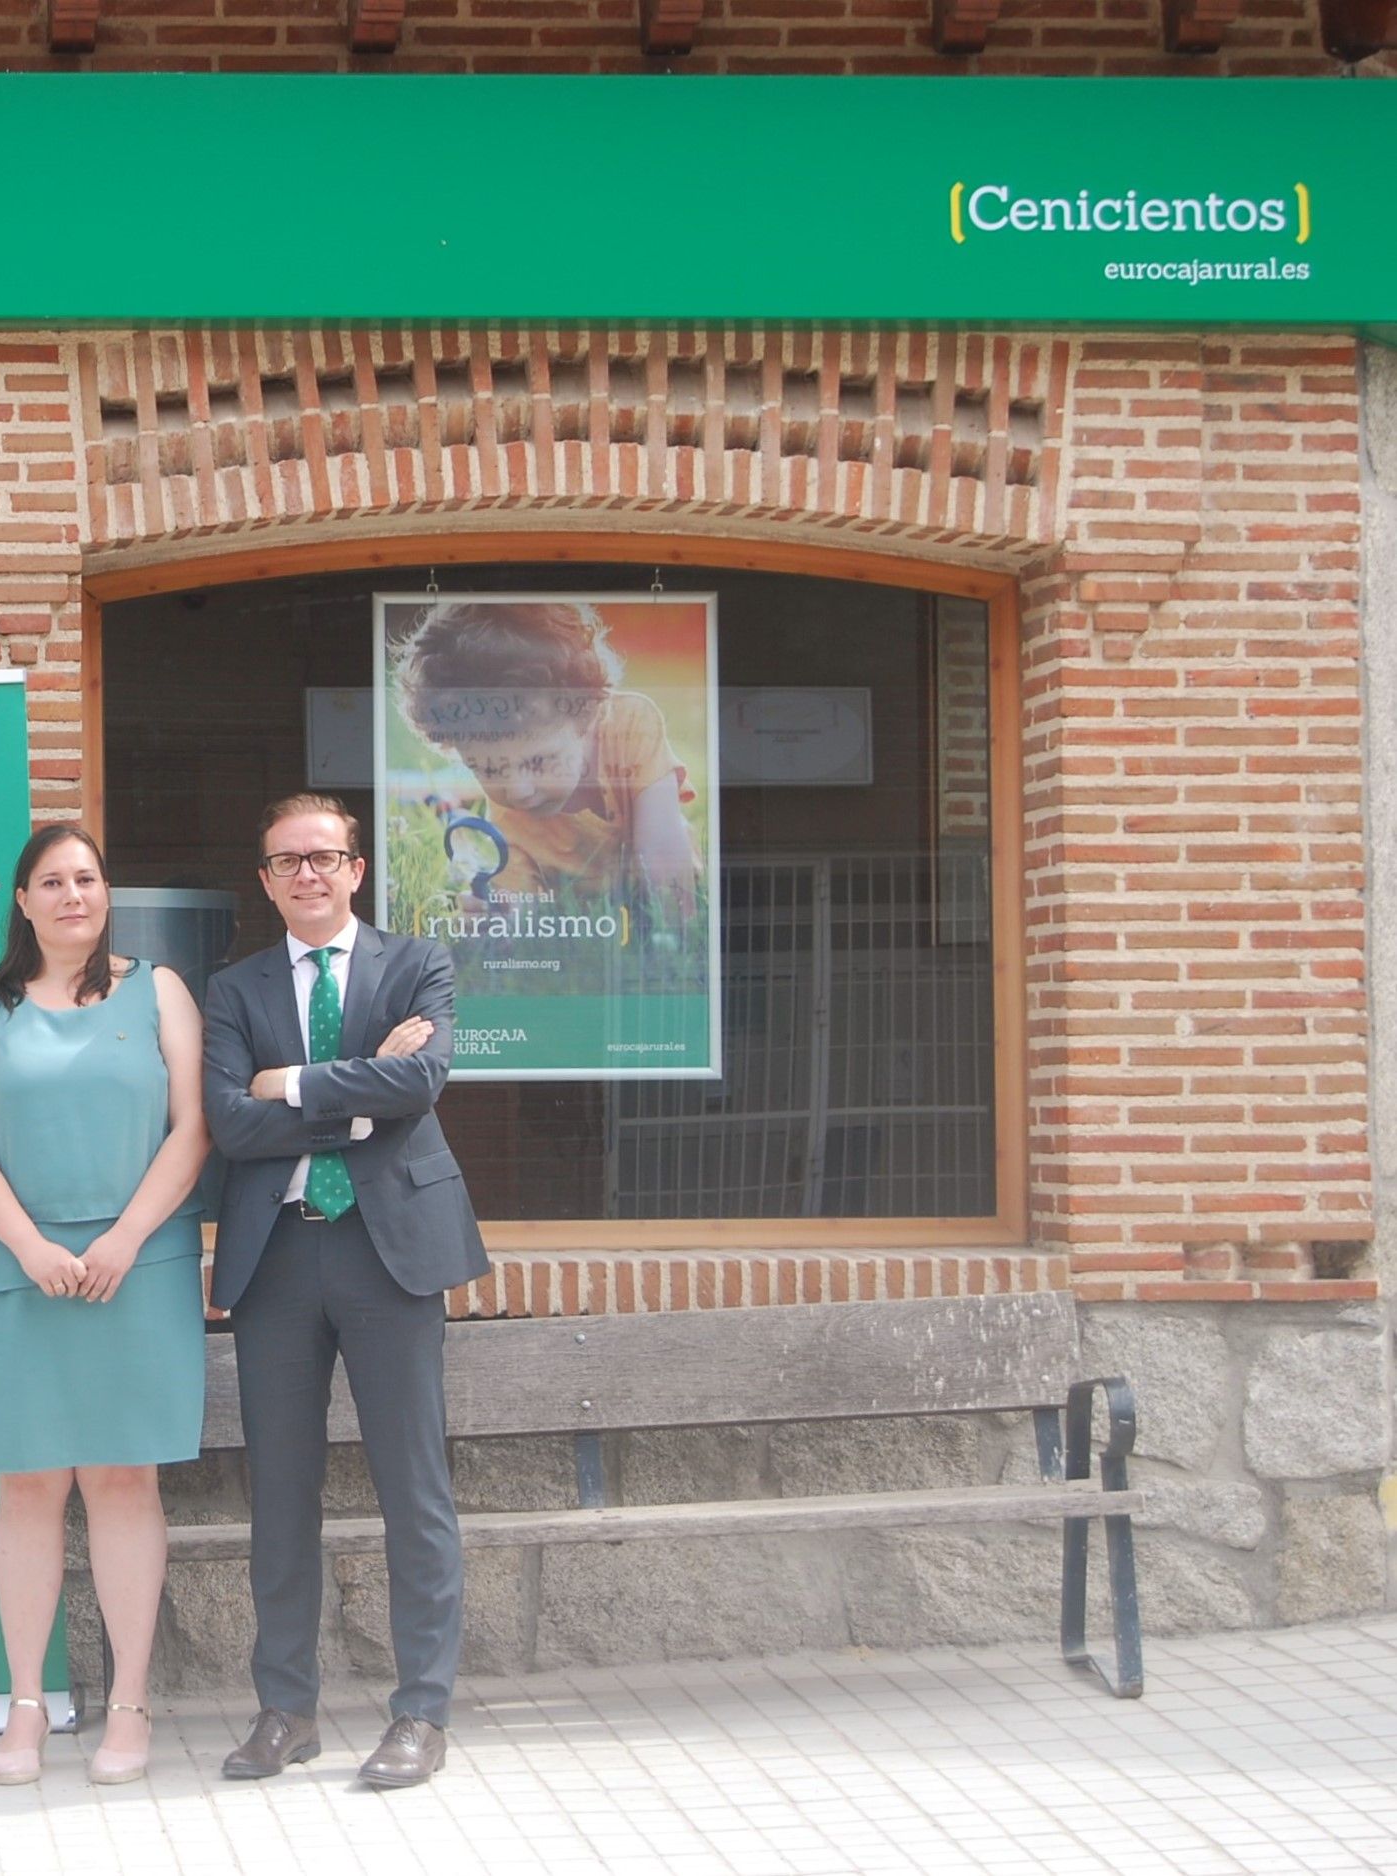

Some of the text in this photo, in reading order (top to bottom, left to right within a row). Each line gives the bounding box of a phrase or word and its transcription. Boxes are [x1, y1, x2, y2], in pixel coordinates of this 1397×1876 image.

[1104, 258, 1310, 286] eurocajarural.es
[488, 889, 555, 903] únete al
[483, 959, 560, 971] ruralismo.org
[607, 1043, 685, 1054] eurocajarural.es
